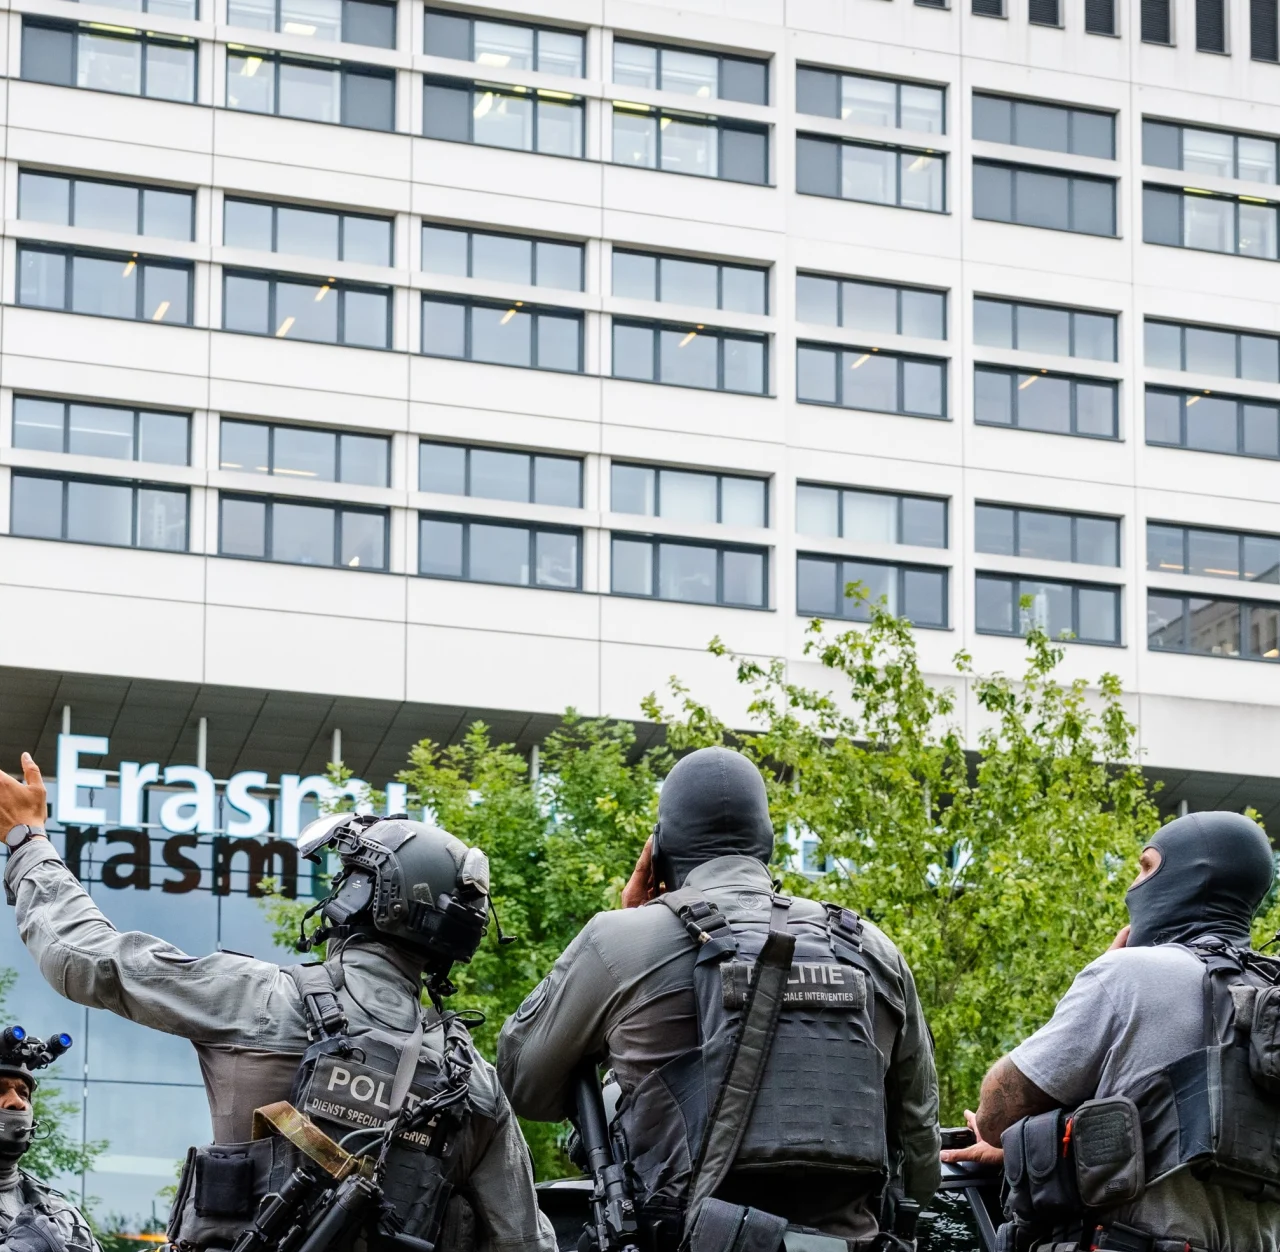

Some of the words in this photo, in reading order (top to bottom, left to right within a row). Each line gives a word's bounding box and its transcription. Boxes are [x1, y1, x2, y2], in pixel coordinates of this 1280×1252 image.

[57, 733, 436, 840] Erasm
[65, 825, 297, 900] rasm
[747, 965, 845, 985] LITIE
[783, 992, 803, 1002] CIALE
[805, 991, 854, 1002] INTERVENTIES
[312, 1098, 346, 1117] DIENST
